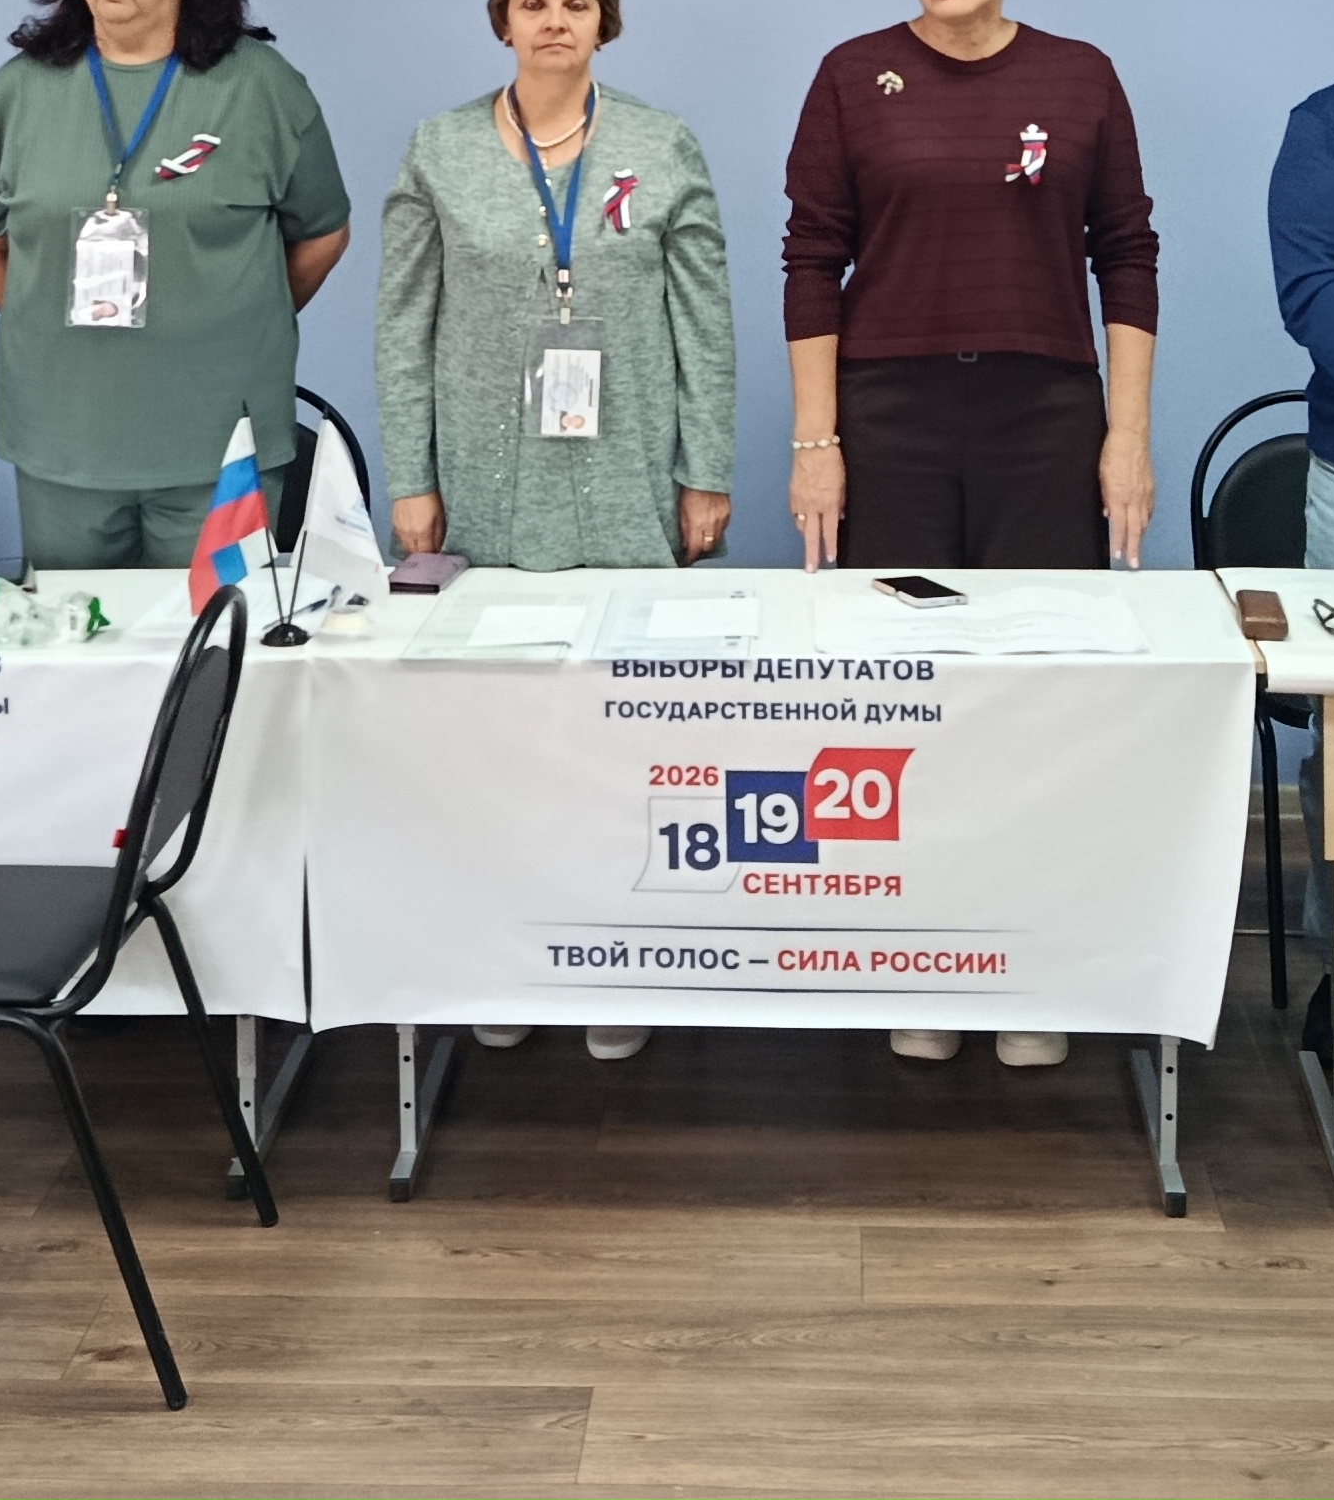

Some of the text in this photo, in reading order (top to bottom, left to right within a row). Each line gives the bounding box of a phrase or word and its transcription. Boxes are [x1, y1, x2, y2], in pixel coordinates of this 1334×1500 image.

[753, 658, 935, 682] ДЕПУТАТОВ
[604, 698, 942, 724] ГОСУДАРСТВЕННОЙ ДУМЫ
[648, 765, 719, 786] 2026
[658, 767, 893, 870] 18 19 20
[743, 872, 902, 897] СЕНТЯБРЯ
[547, 941, 629, 968] ТВОЙ
[639, 946, 741, 971] ГОЛОС
[776, 949, 862, 972] СИЛА
[870, 951, 1007, 975] РОССИИ!
